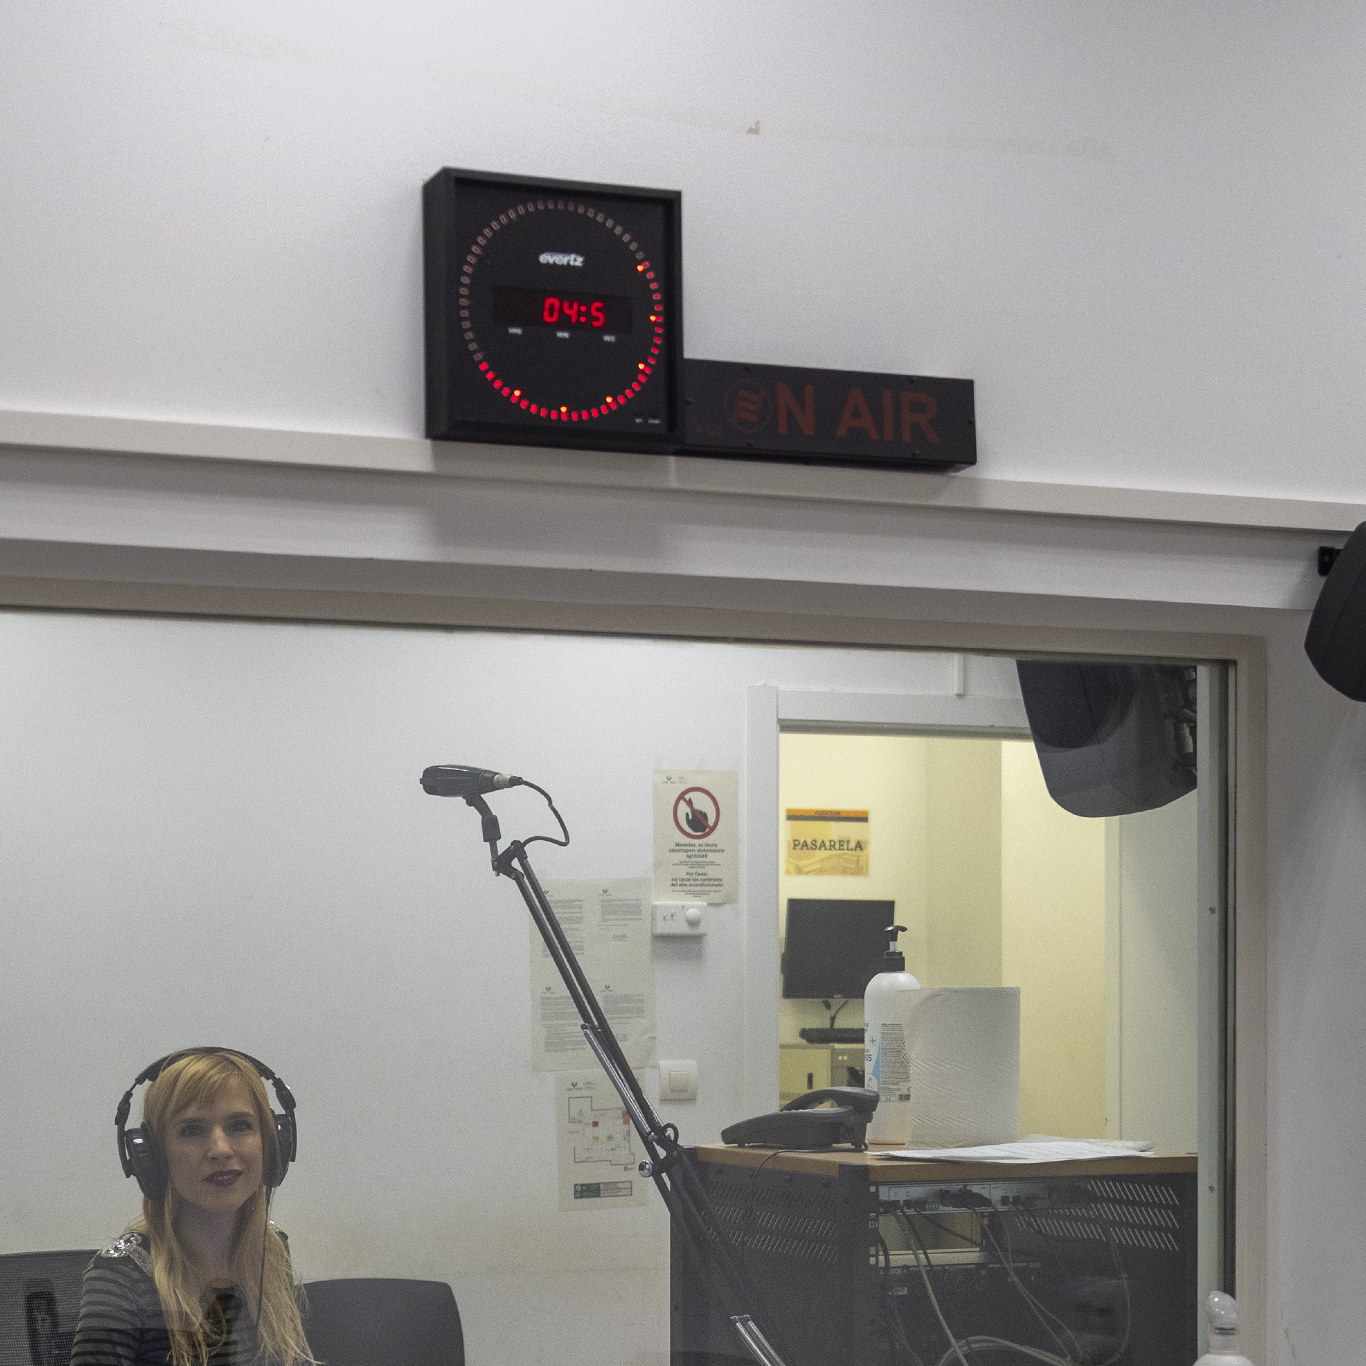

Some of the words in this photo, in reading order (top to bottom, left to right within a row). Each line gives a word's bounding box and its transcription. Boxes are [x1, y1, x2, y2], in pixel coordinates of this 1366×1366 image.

[539, 252, 584, 266] evertz
[836, 387, 940, 444] AIR
[792, 839, 864, 851] PASARELA
